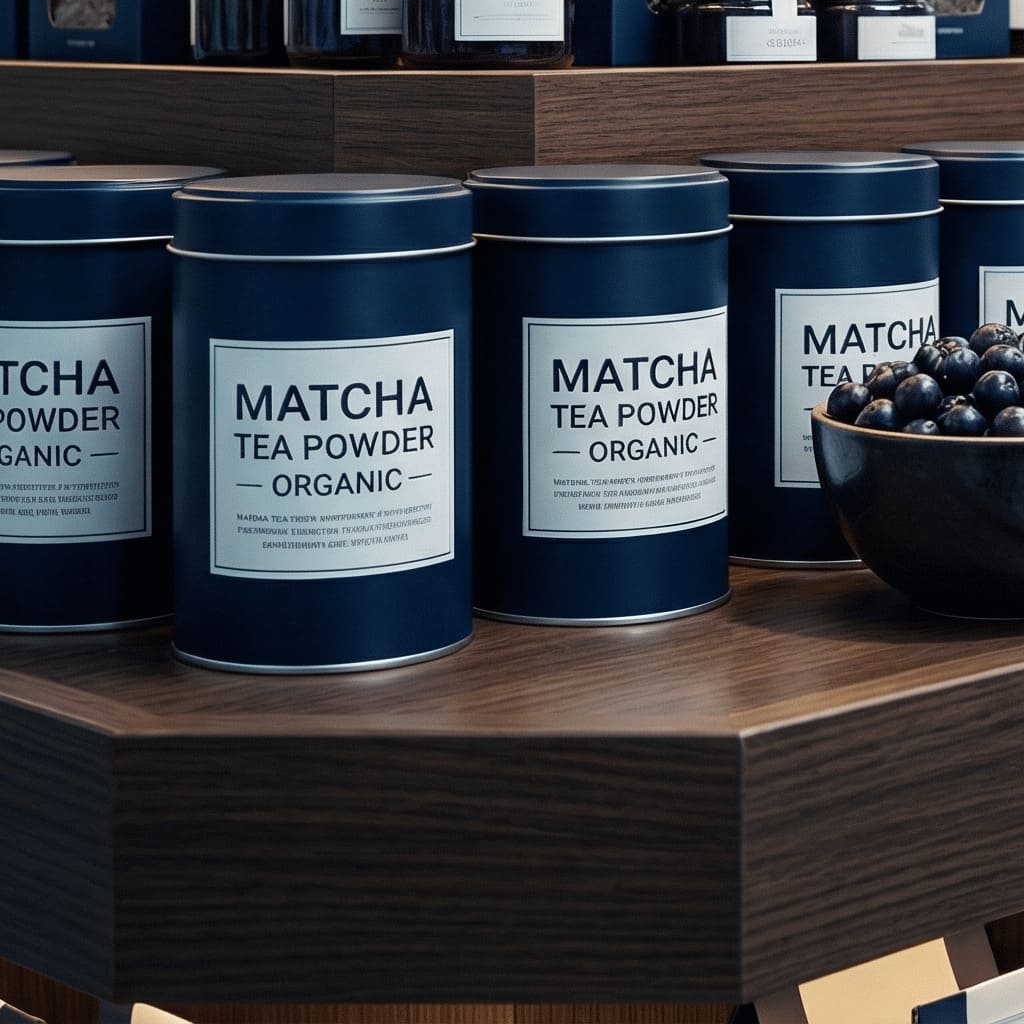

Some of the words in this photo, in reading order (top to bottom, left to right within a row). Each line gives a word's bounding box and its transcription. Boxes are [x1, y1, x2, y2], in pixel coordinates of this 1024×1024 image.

[803, 314, 937, 355] MATCHA
[552, 347, 718, 393] MATCHA
[801, 365, 853, 387] TEA
[236, 376, 434, 422] MATCHA
[550, 403, 609, 429] TEA
[618, 392, 718, 428] POWDER
[234, 433, 293, 460] TEA
[303, 425, 434, 461] POWDER
[588, 432, 699, 463] ORGANIC
[271, 468, 403, 497] ORGANIC
